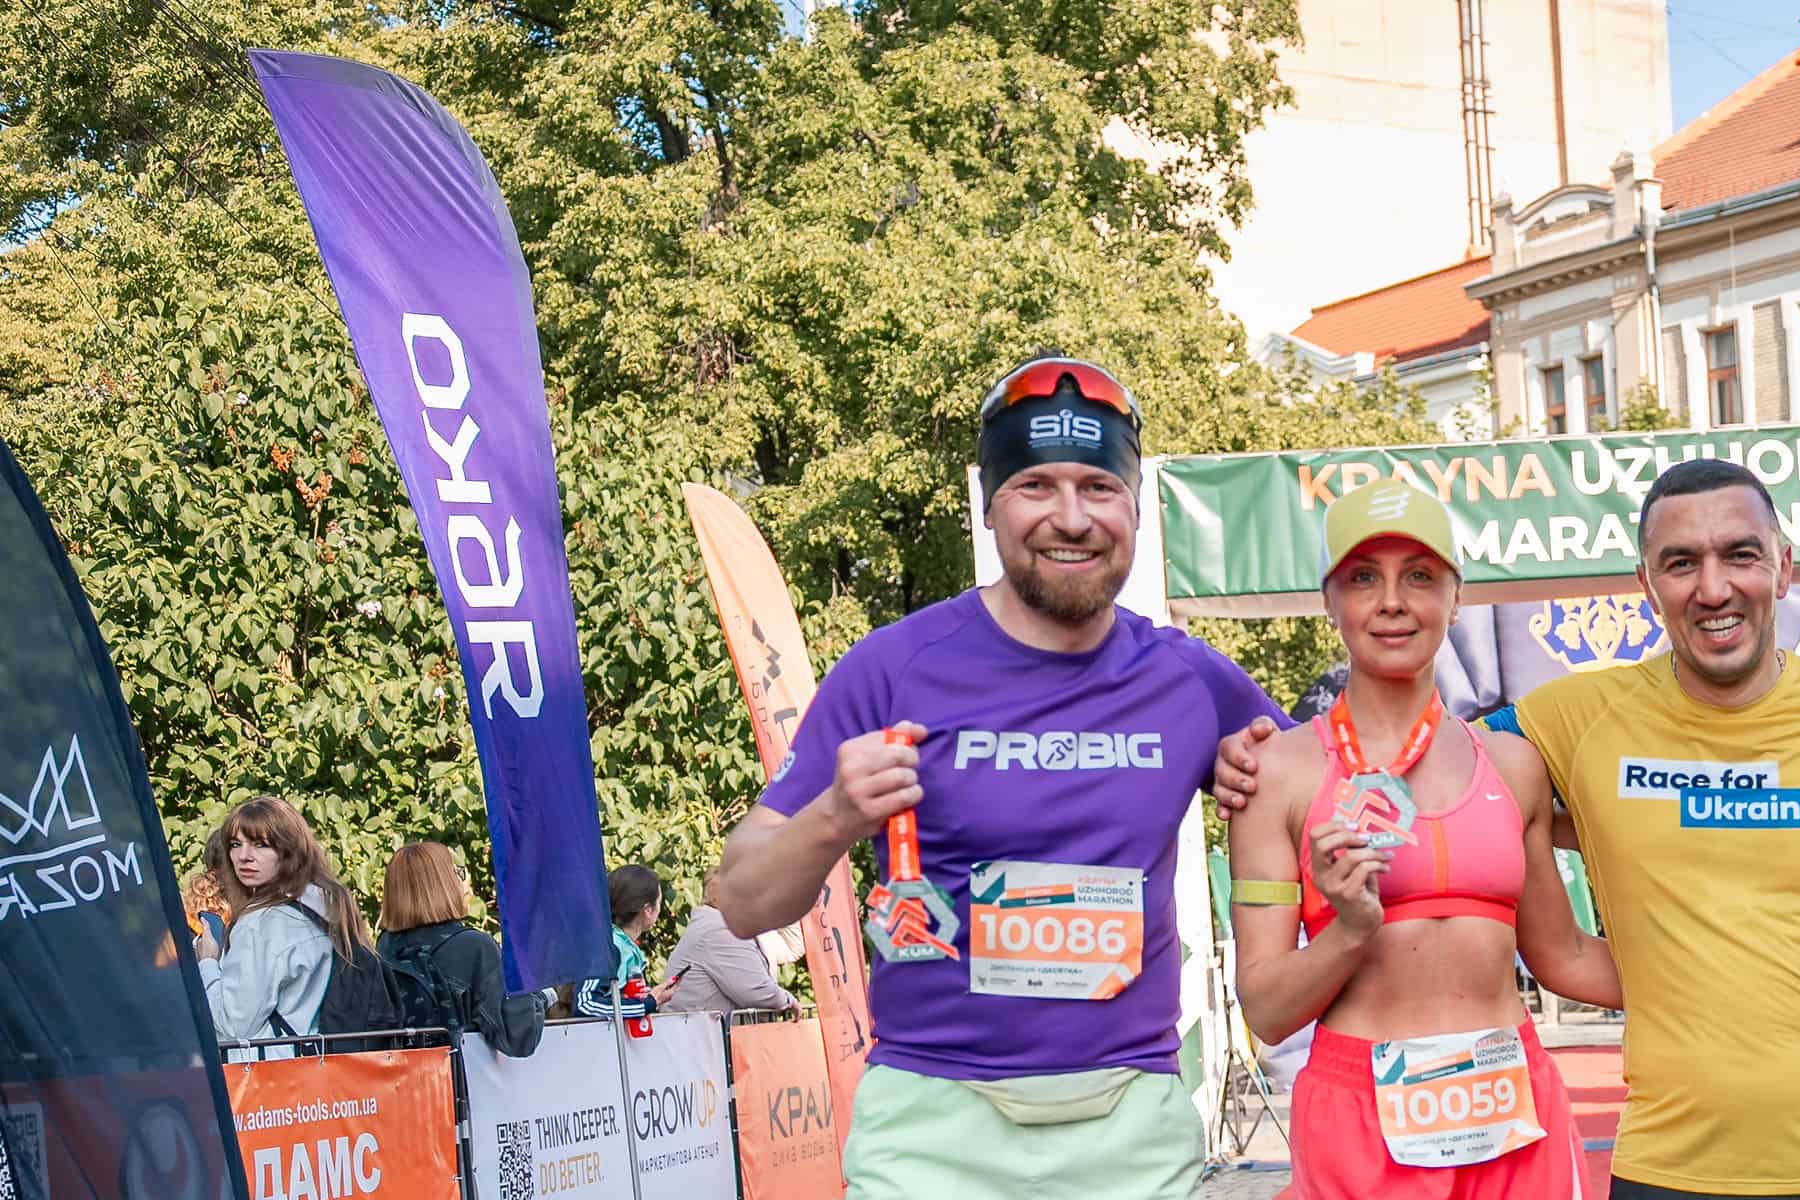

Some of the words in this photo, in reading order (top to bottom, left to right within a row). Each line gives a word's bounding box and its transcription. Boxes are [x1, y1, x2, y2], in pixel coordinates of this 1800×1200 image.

[954, 731, 1164, 770] PROBIG
[1625, 764, 1711, 789] Race
[1720, 769, 1768, 790] for
[1078, 895, 1134, 905] MARATHON
[979, 913, 1127, 956] 10086
[233, 1097, 377, 1132] w.adams-tools.com.ua
[1387, 1077, 1517, 1129] 10059
[535, 1113, 572, 1151] THINK
[572, 1105, 621, 1143] DEEPER.
[540, 1161, 557, 1196] DO
[559, 1151, 605, 1191] BETTER.
